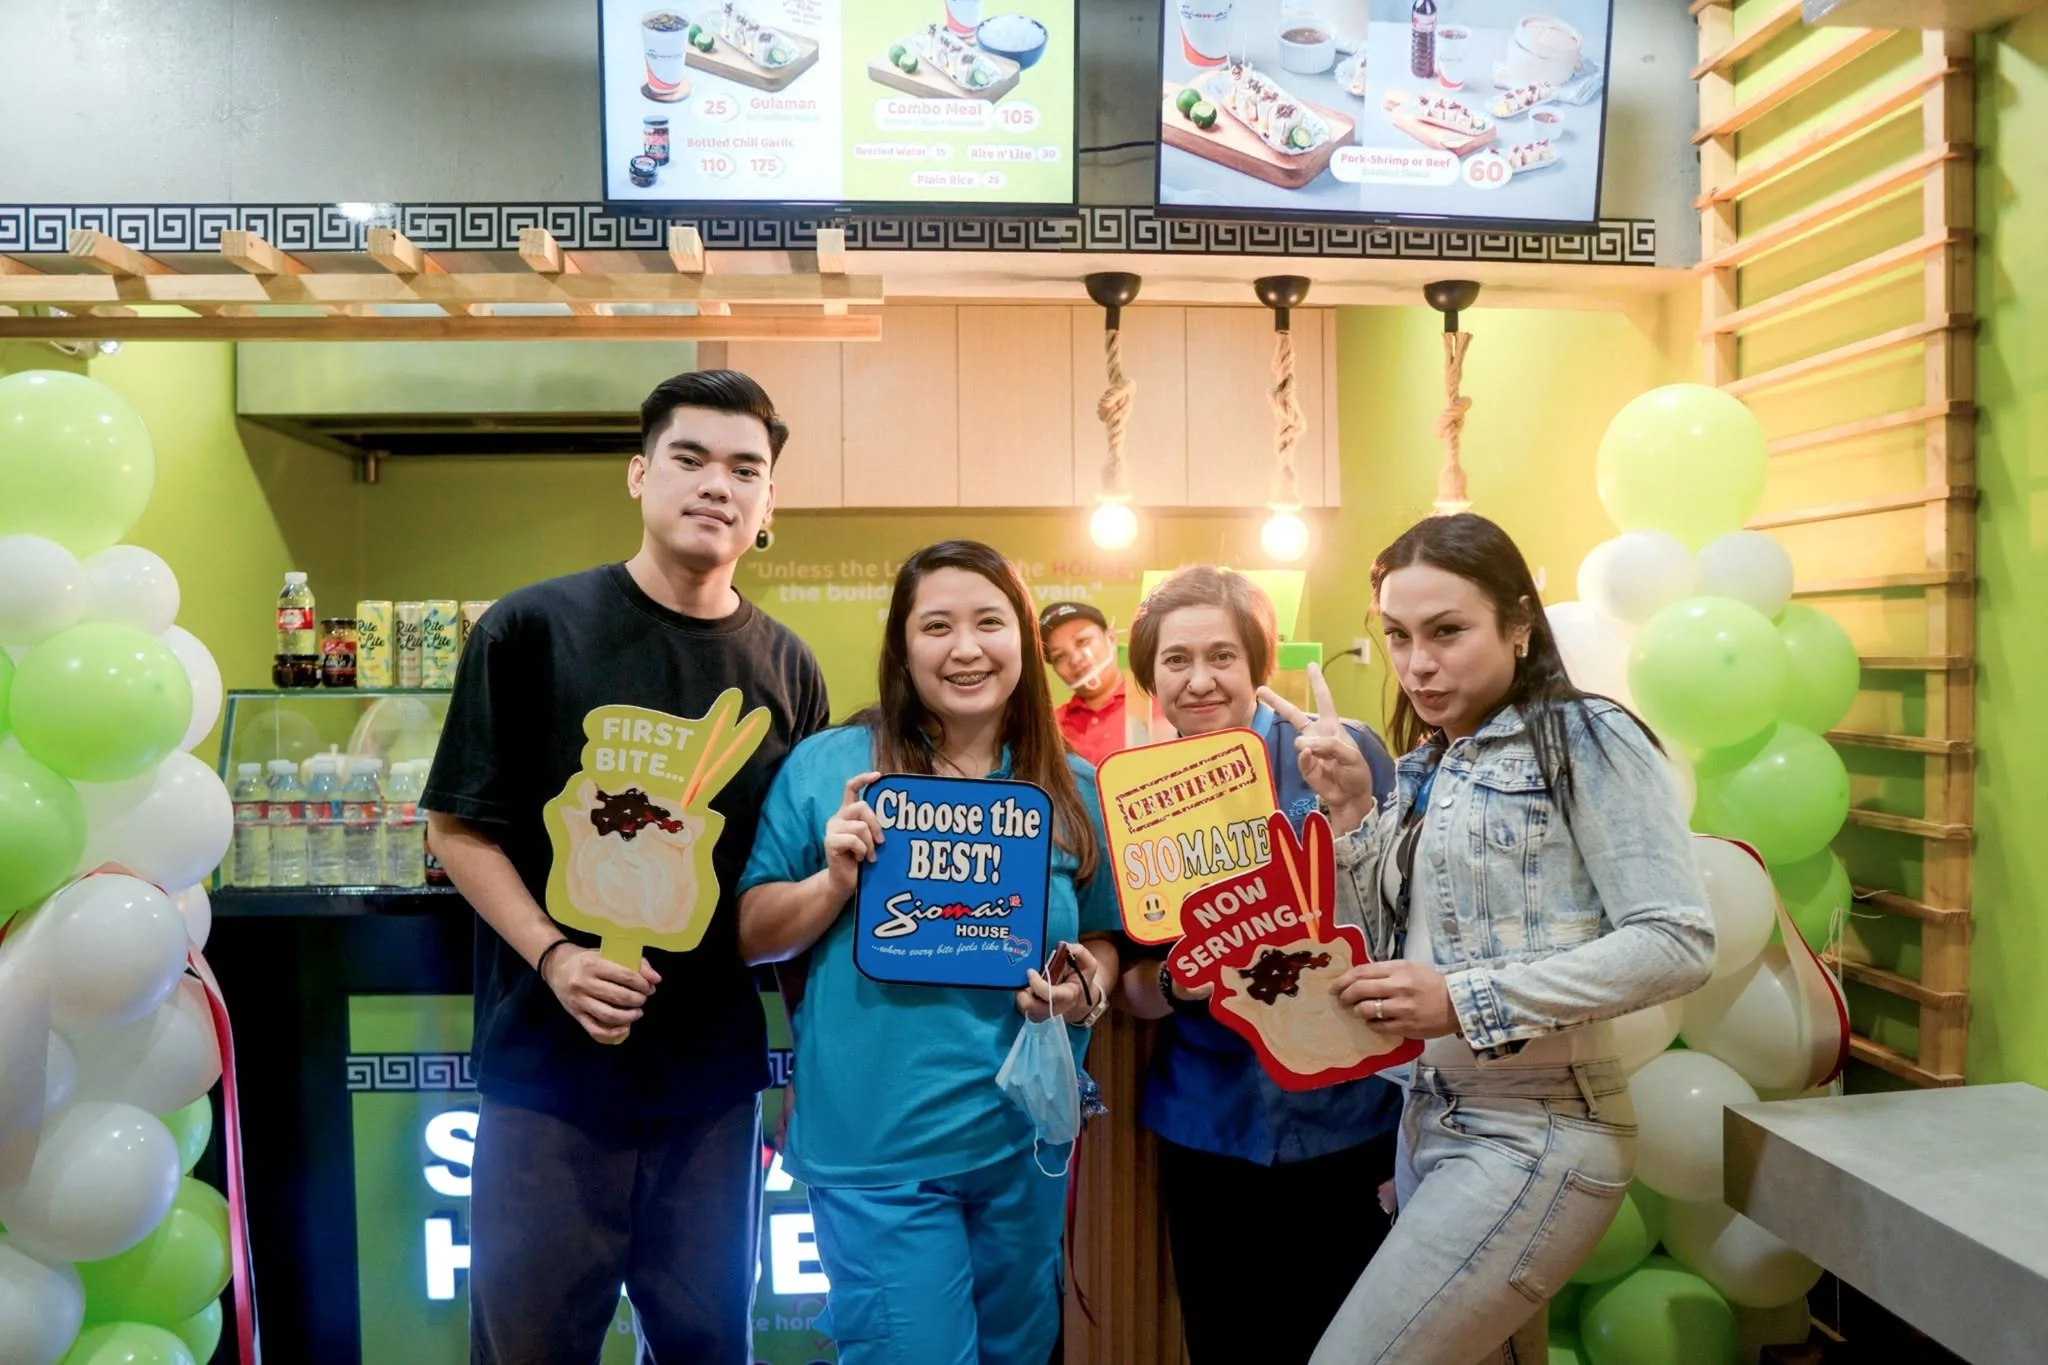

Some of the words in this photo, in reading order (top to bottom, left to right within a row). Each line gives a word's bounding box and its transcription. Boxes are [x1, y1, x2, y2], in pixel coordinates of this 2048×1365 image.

[704, 100, 727, 115] 25
[750, 97, 817, 110] Gulaman
[887, 102, 942, 116] Combo
[945, 103, 983, 116] Meal
[1001, 109, 1034, 125] 105
[687, 137, 730, 148] Bottled
[733, 137, 758, 149] Chili
[761, 138, 796, 149] Garlic
[1010, 149, 1032, 161] Lite
[1340, 153, 1410, 168] Pork-Shrimp
[1412, 158, 1423, 167] or
[1426, 157, 1452, 169] Beef
[700, 158, 727, 172] 110
[750, 158, 778, 172] 175
[1468, 159, 1504, 183] 60
[917, 174, 947, 185] Plain
[950, 174, 975, 186] Rice
[747, 560, 835, 580] "Unless
[840, 560, 879, 579] the
[779, 583, 821, 603] the
[602, 717, 695, 751] FIRST
[595, 747, 685, 783] BITE...
[1127, 758, 1247, 822] CERTIFIED
[875, 788, 984, 835] Choose
[989, 797, 1042, 839] the
[907, 838, 1001, 885] BEST!
[1123, 816, 1273, 890] SIOMATE
[1192, 875, 1268, 929] NOW
[873, 891, 1012, 939] Siomai
[956, 924, 1010, 939] HOUSE
[909, 948, 934, 957] every
[937, 944, 954, 955] bite
[956, 942, 978, 956] feels
[981, 941, 1000, 952] like
[1175, 904, 1322, 979] SERVING...
